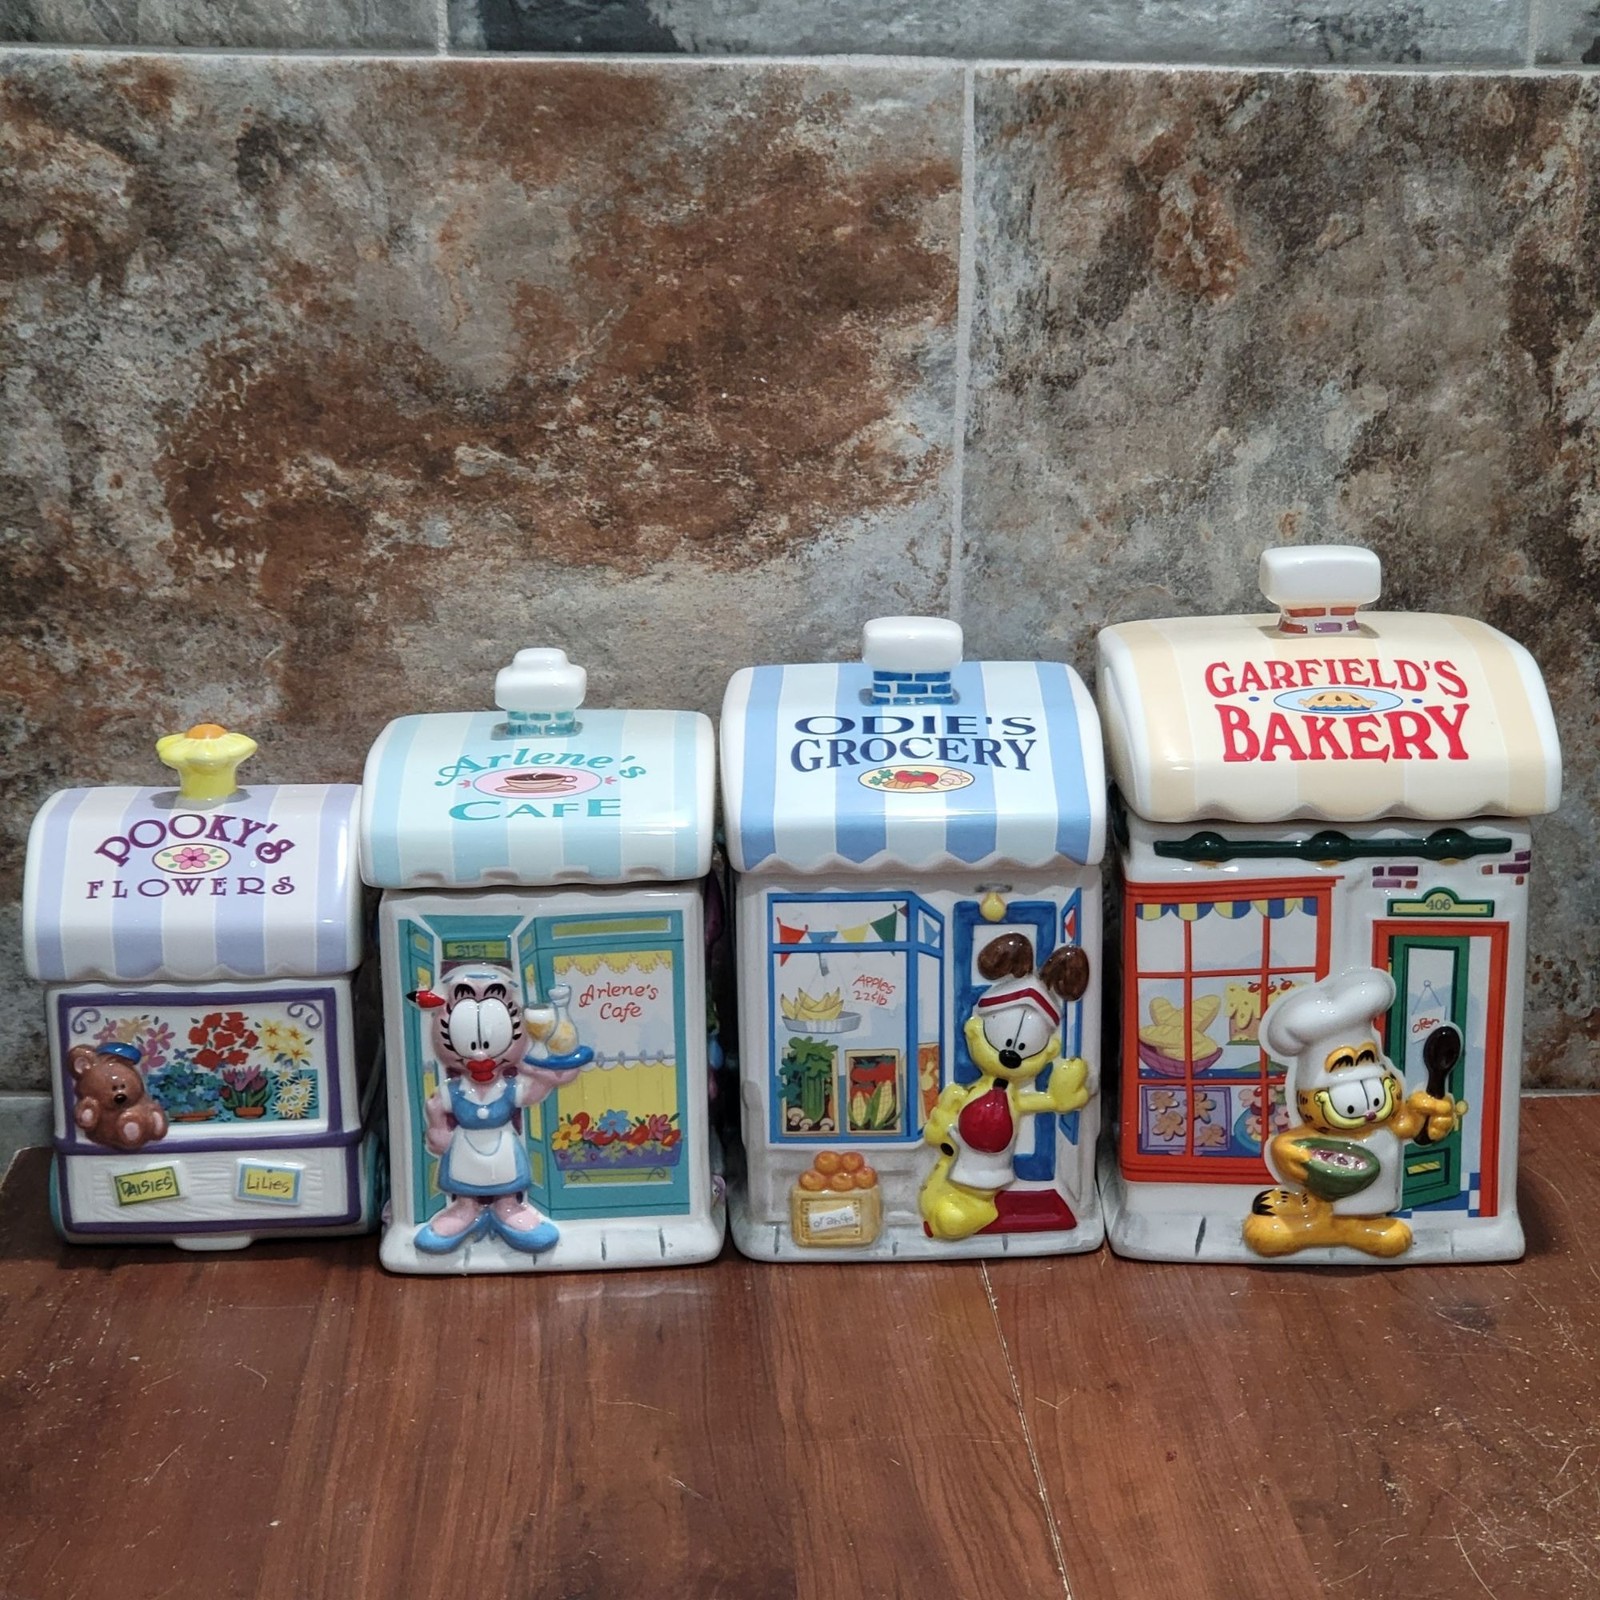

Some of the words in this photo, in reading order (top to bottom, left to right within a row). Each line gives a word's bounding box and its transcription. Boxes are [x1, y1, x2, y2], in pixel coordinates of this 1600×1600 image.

[1204, 658, 1469, 699] GARFIELD'S
[794, 715, 1037, 736] ODIE'S
[1214, 703, 1470, 763] BAKERY
[434, 747, 647, 787] Arlene's
[790, 737, 1037, 773] GROCERY
[448, 798, 622, 821] CAFE
[94, 813, 296, 868] POOKY'S
[86, 876, 296, 899] FLOWERS
[1425, 898, 1452, 911] 406
[578, 981, 659, 1008] Arlene's
[600, 1002, 642, 1023] Cafe
[120, 1175, 174, 1198] DAISIES
